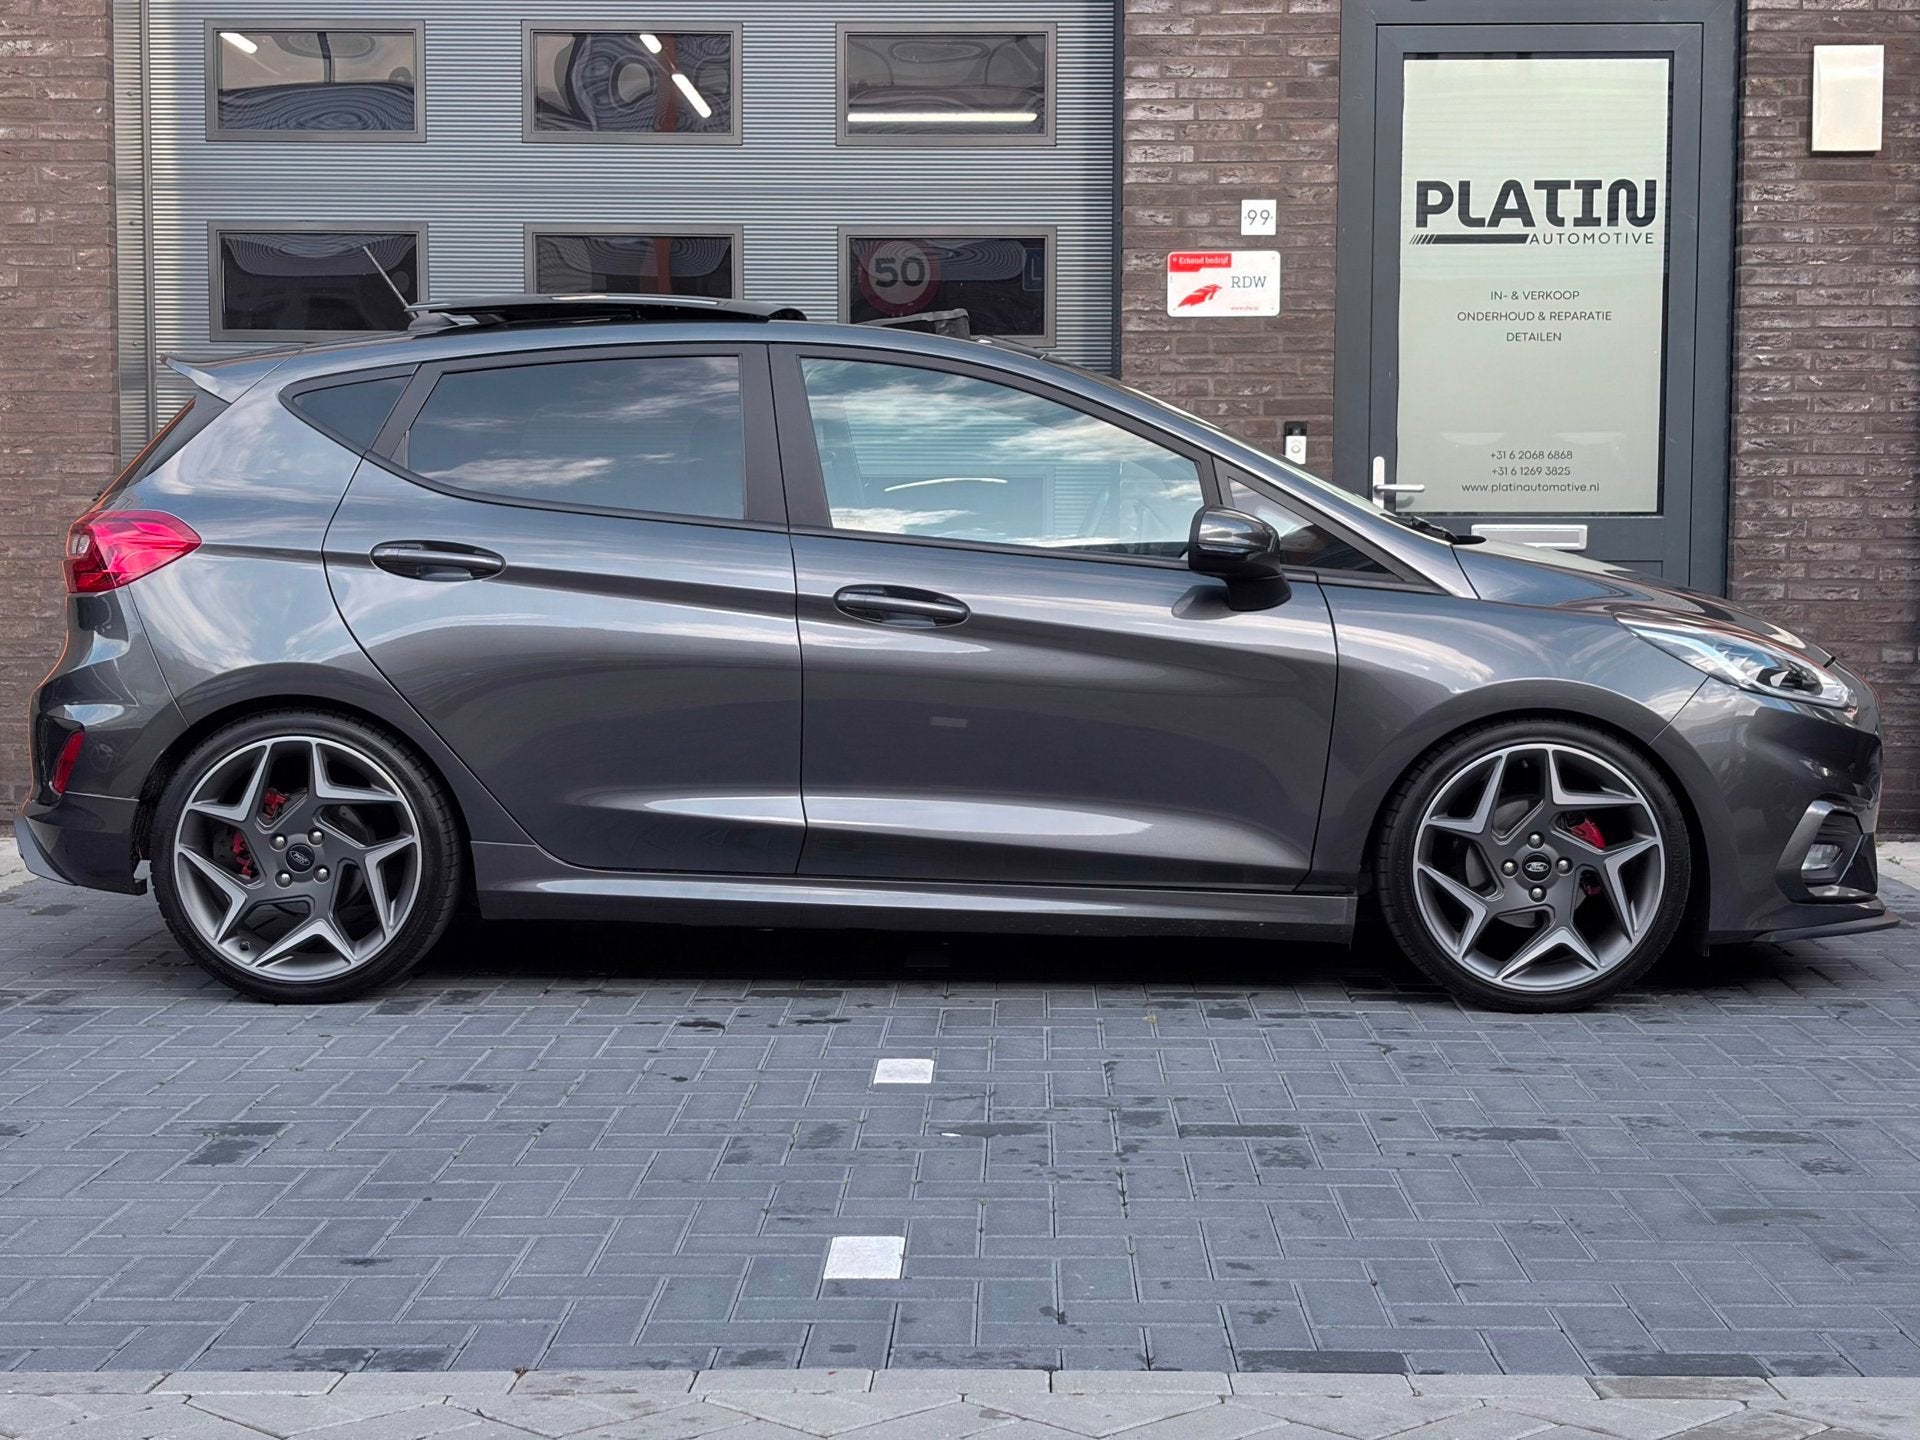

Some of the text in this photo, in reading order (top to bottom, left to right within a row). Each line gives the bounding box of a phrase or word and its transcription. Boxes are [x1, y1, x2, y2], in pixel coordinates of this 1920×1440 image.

[1416, 179, 1657, 228] PLATIN
[1247, 209, 1270, 225] 99
[1529, 232, 1654, 245] AUTOMOTIVE
[1178, 256, 1229, 265] Erkend bedrijf
[875, 256, 925, 288] 50
[1230, 275, 1267, 288] RDW
[1490, 290, 1580, 301] IN- & VERKOOP
[1457, 311, 1612, 322] ONDERHOUD & REPARATIE
[1506, 332, 1562, 342] DETAILEN
[1490, 450, 1573, 460] +31 6 2068 6868
[1491, 466, 1571, 476] +31 6 1269 3825
[1461, 482, 1600, 493] www.platinautomotive.nl
